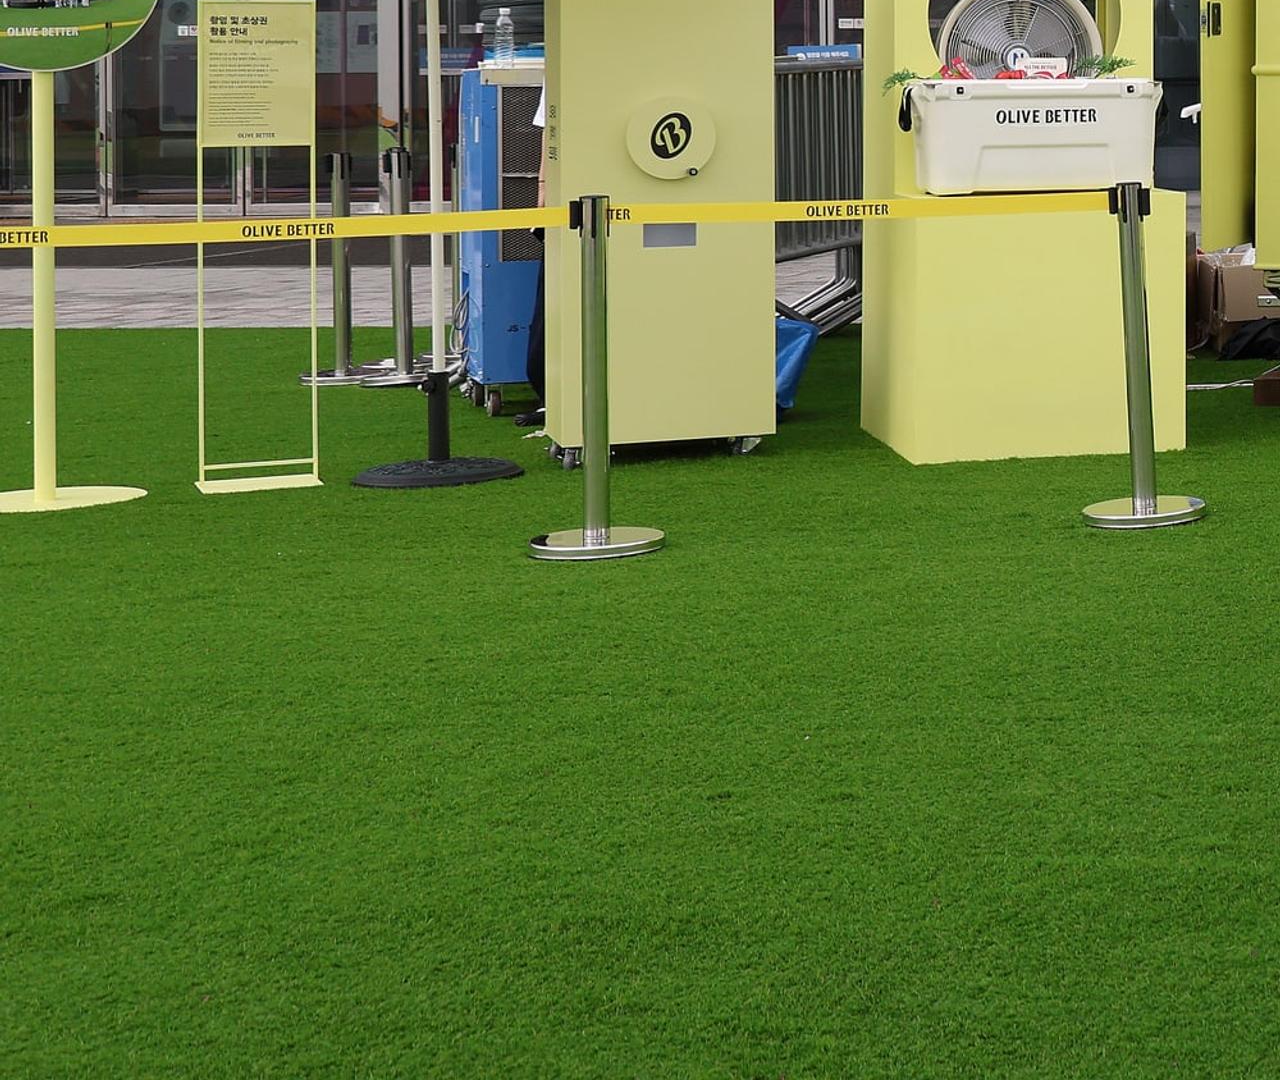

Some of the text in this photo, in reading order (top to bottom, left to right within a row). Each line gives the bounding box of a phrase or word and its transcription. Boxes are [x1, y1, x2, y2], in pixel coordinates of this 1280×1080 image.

[7, 27, 79, 37] OLIVE BETTER
[996, 108, 1097, 124] OLIVE BETTER
[608, 209, 631, 221] TER
[806, 204, 889, 217] OLIVE BETTER
[0, 230, 49, 243] BETTER
[242, 223, 335, 237] OLIVE BETTER
